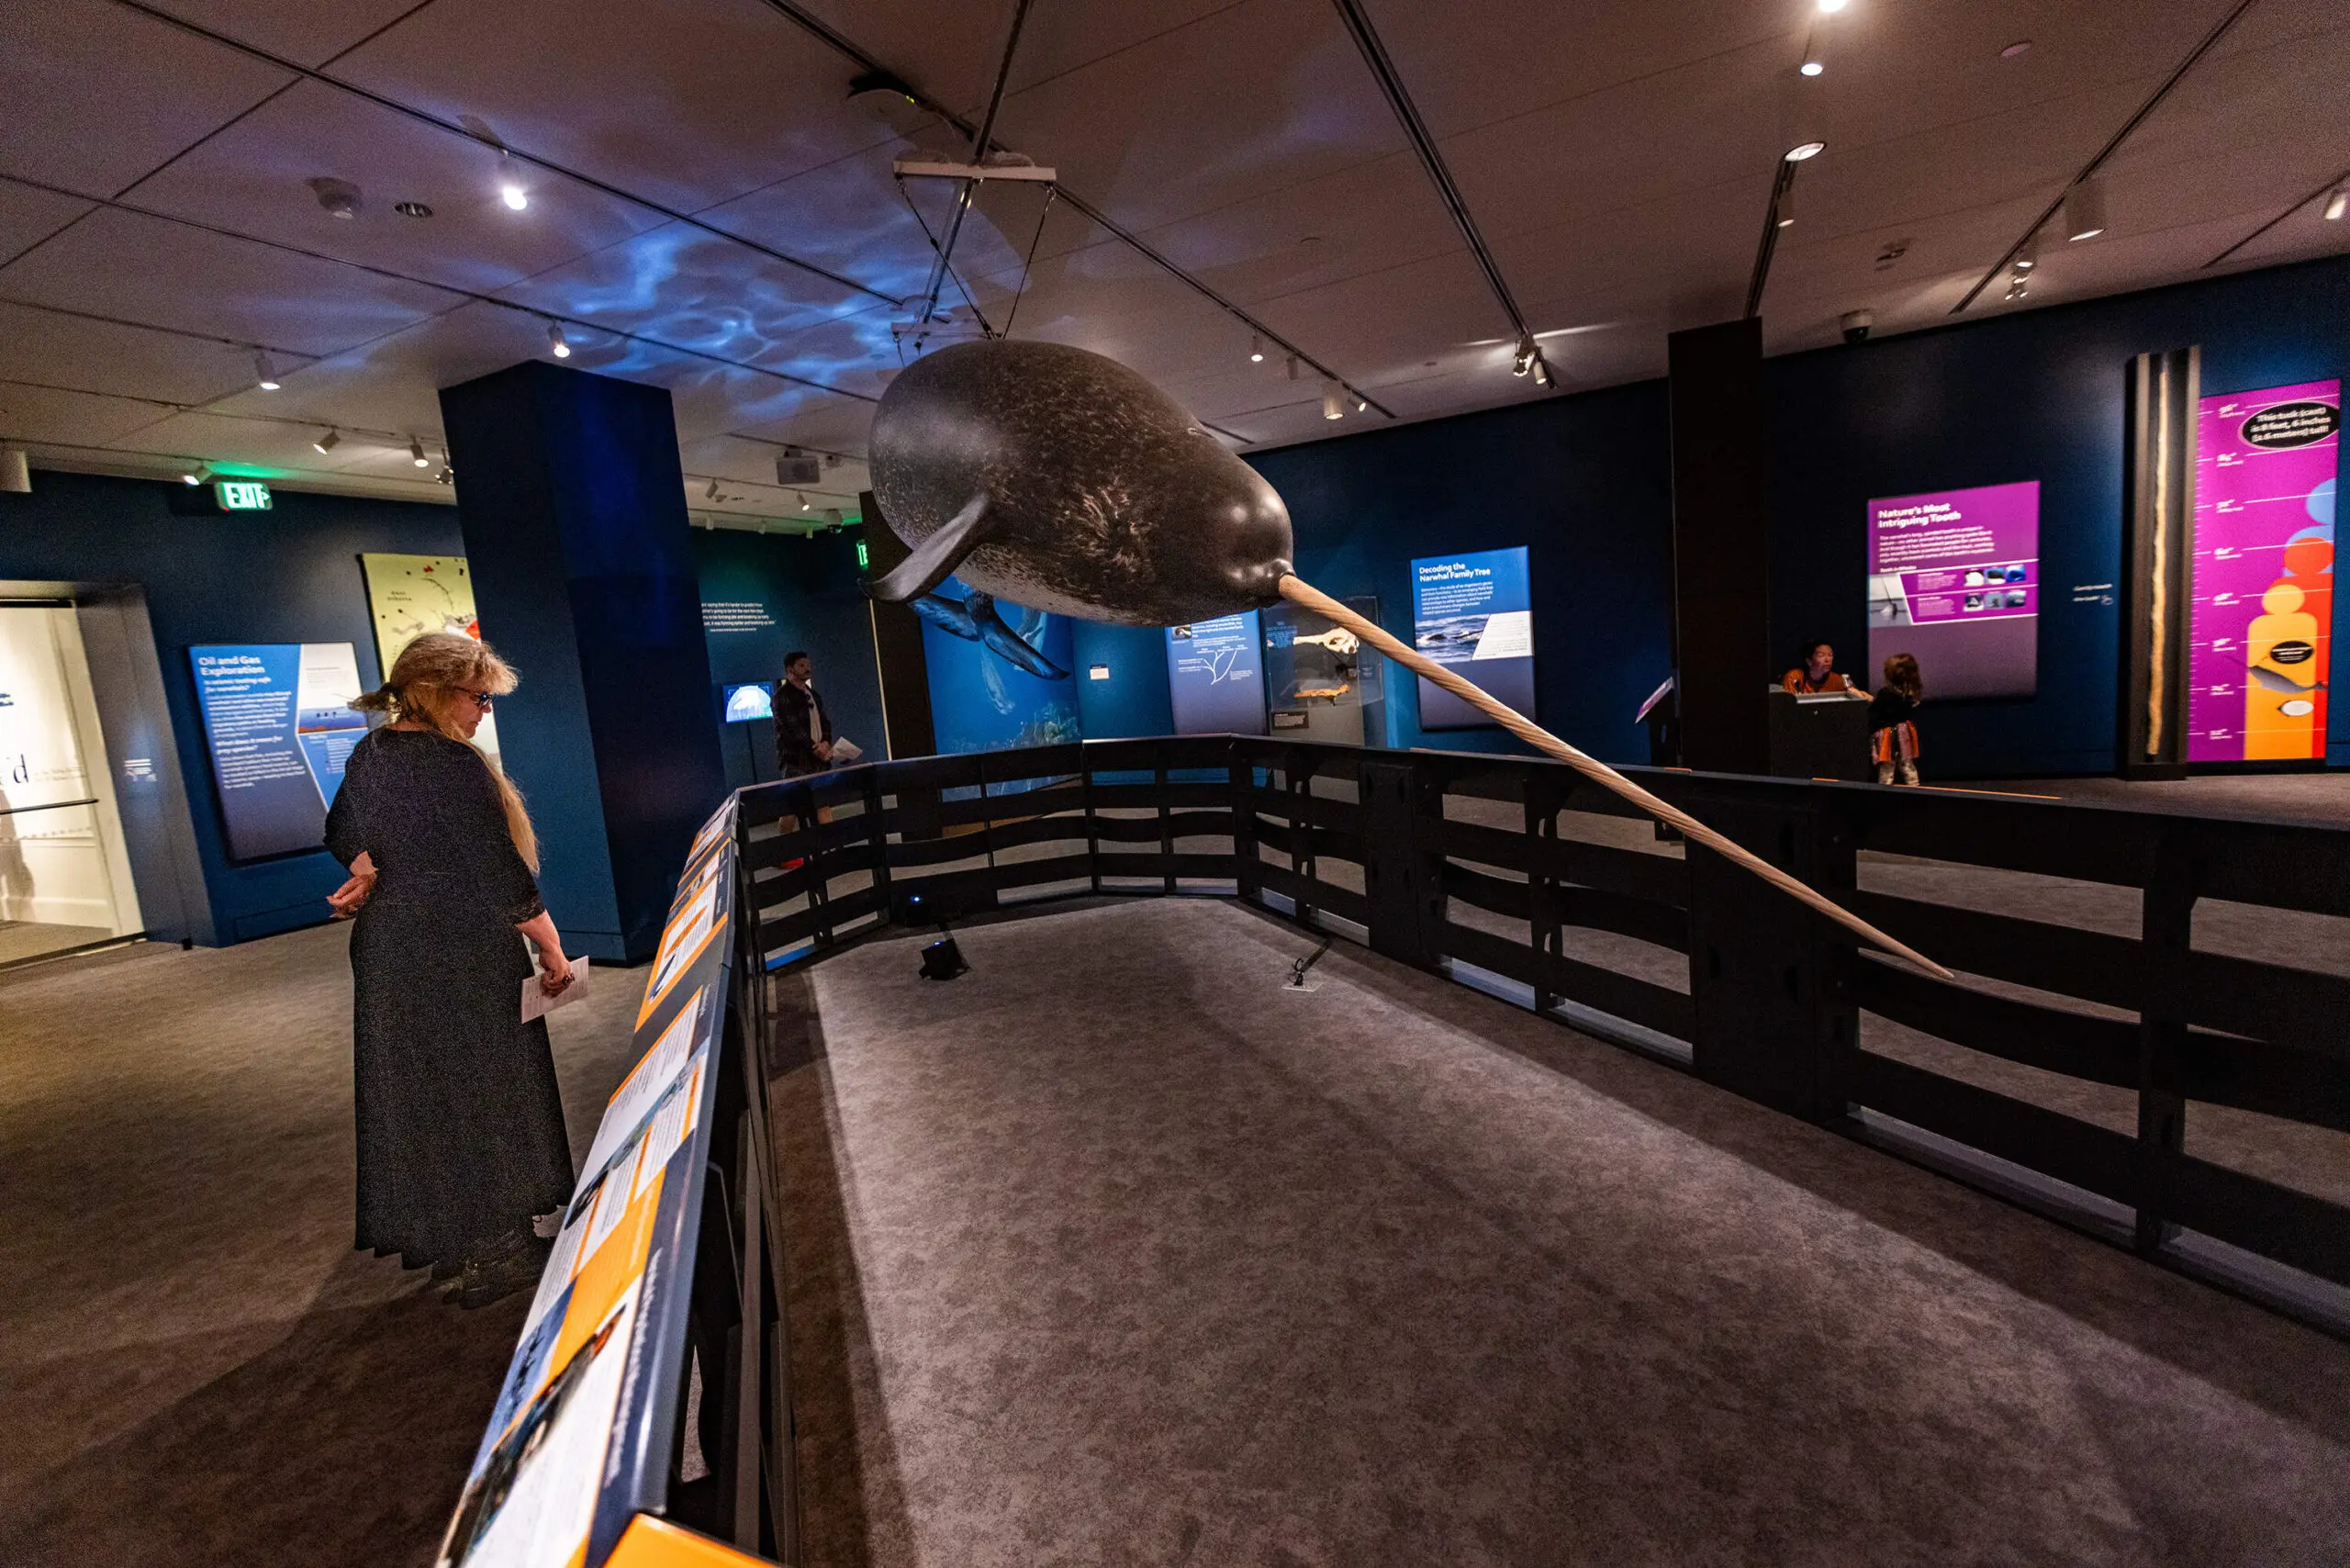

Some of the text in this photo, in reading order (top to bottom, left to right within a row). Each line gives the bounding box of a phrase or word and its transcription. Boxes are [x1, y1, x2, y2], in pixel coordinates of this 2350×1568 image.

[223, 482, 265, 509] EXIT
[1878, 503, 1951, 519] Nature's Most
[1878, 511, 1961, 529] Intriguing Tooth
[1419, 562, 1465, 575] Decoding the
[1419, 572, 1449, 583] Narwhal
[1449, 569, 1474, 579] Family
[198, 655, 262, 666] Oil and Gas
[200, 665, 265, 677] Exploration
